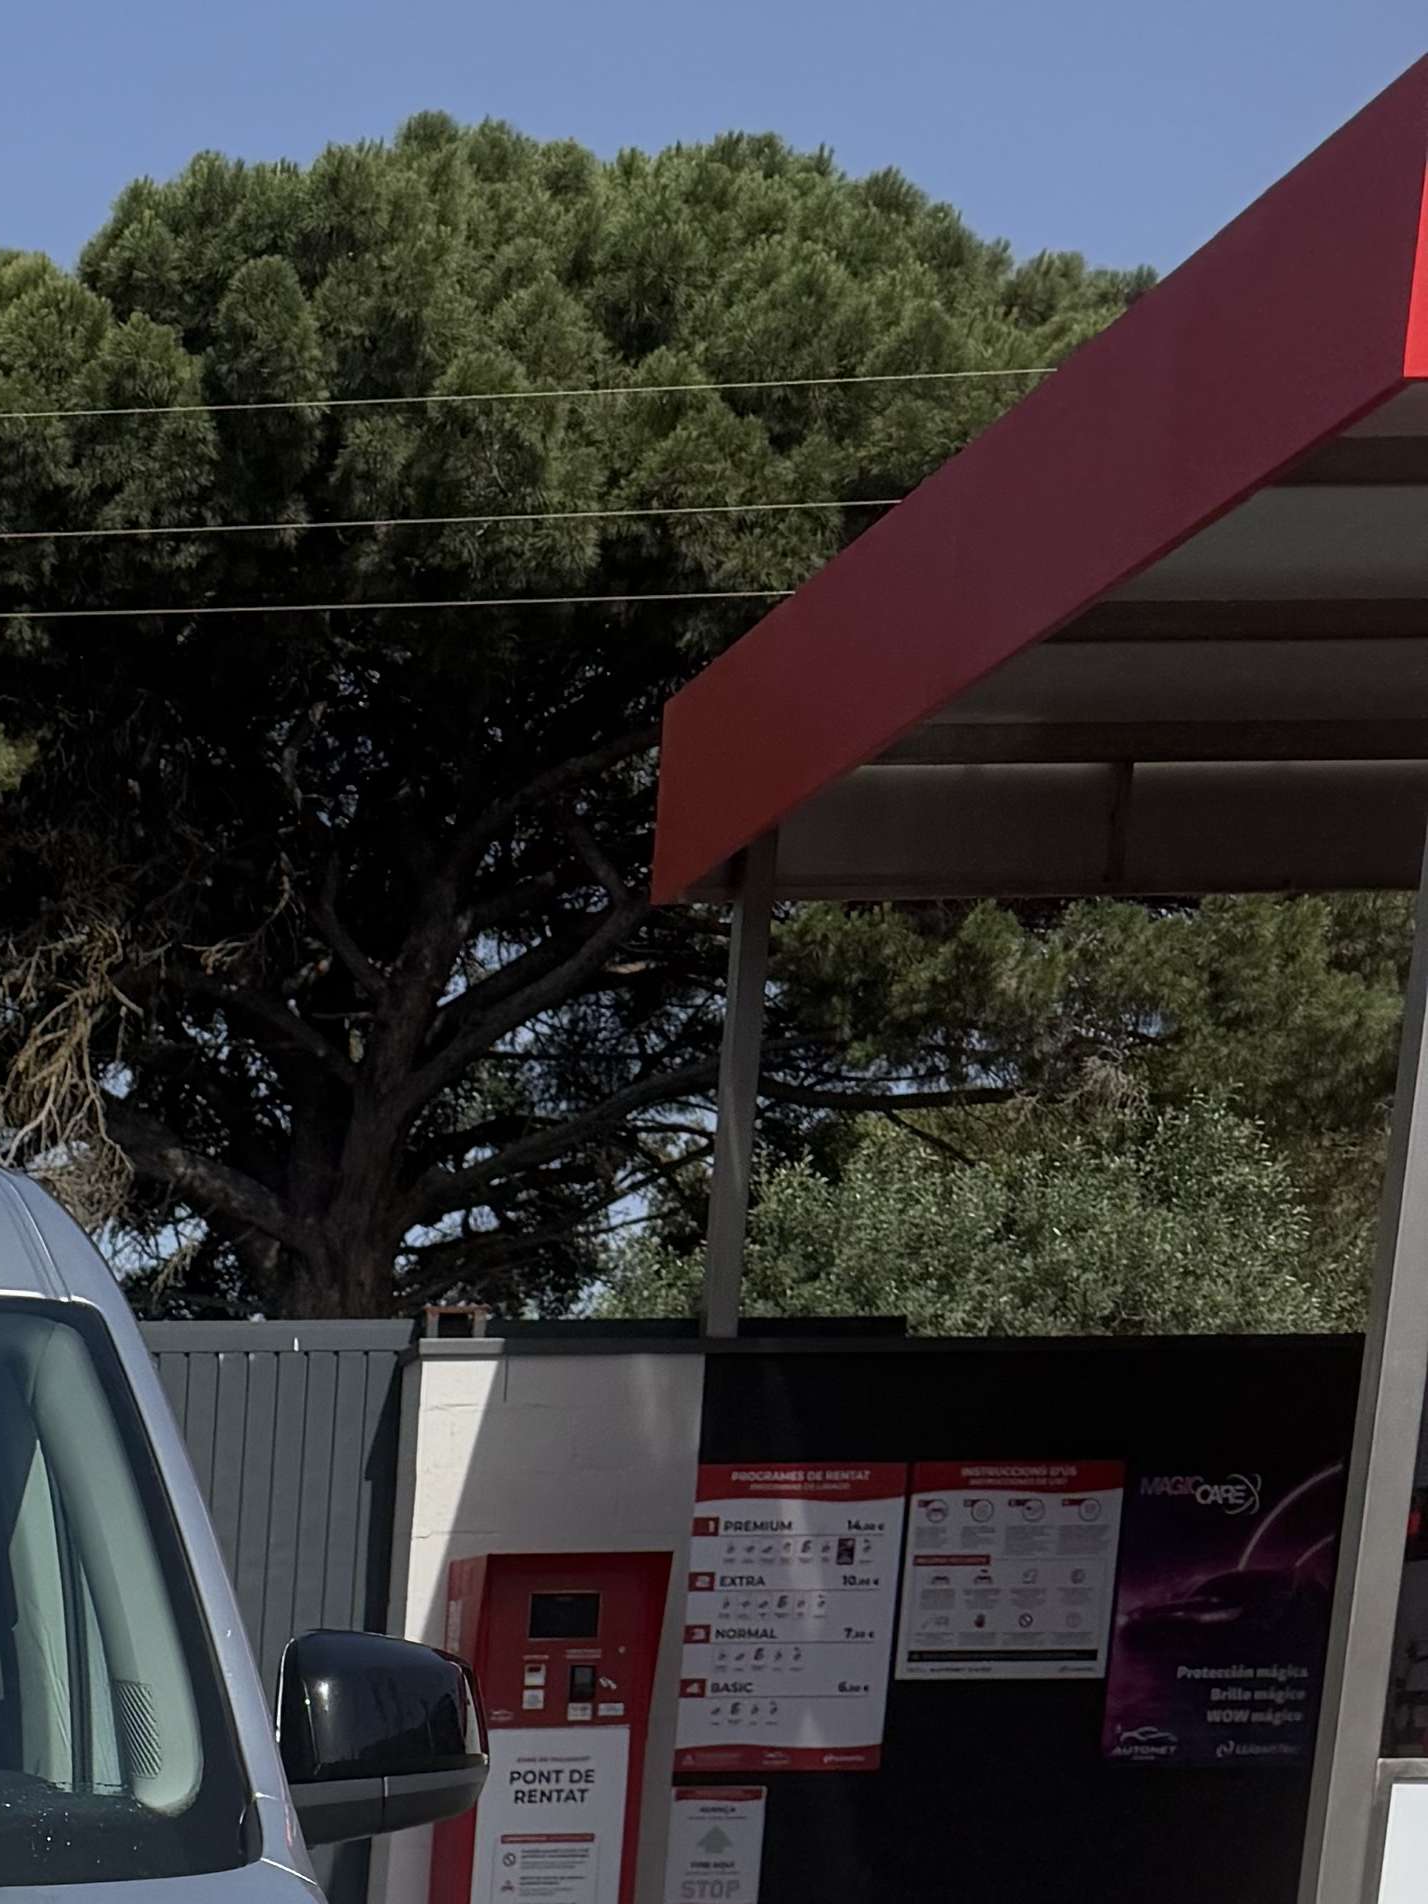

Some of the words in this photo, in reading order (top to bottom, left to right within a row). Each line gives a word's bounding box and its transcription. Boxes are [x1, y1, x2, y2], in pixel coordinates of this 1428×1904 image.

[722, 1520, 793, 1532] PREMIUM
[719, 1575, 766, 1587] EXTRA
[714, 1627, 778, 1639] NORMAL
[710, 1682, 754, 1693] BASIC
[1206, 1708, 1251, 1723] WOW
[509, 1769, 563, 1785] PONT
[568, 1769, 595, 1784] DE
[513, 1788, 590, 1804] RENTAT
[682, 1880, 741, 1899] STOP
